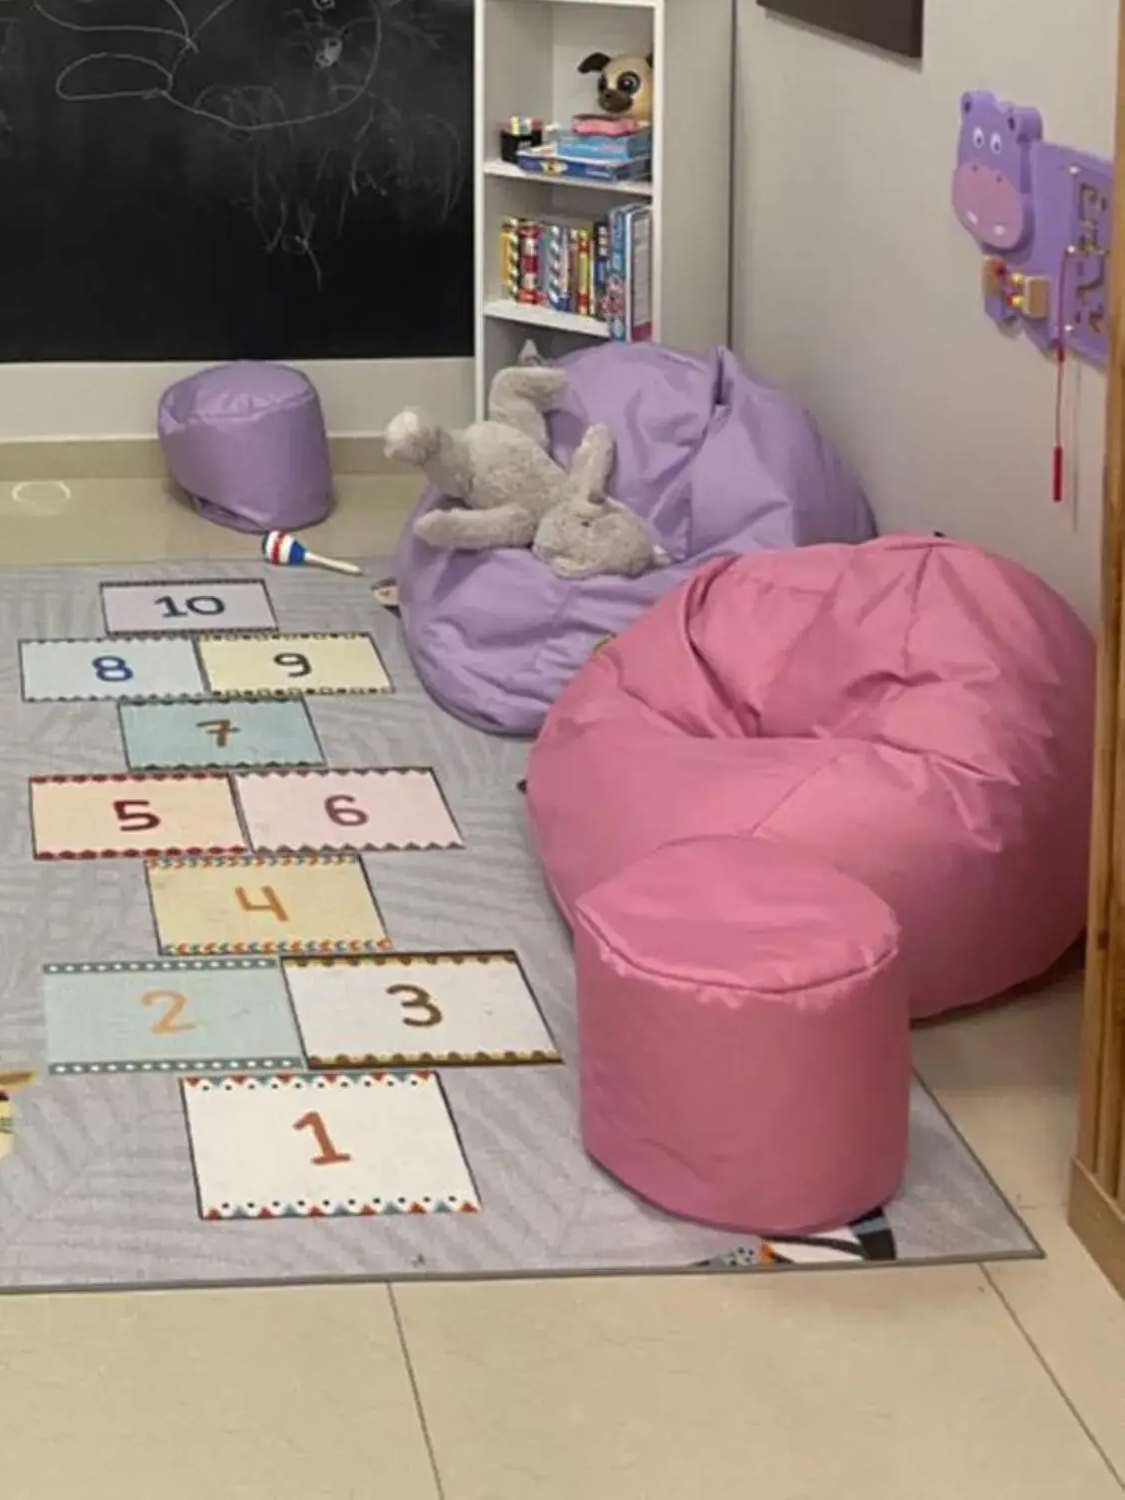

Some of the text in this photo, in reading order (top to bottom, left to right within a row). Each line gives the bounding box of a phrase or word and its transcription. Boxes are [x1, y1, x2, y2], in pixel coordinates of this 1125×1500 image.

[154, 595, 226, 618] 10
[92, 655, 134, 682] 8
[273, 652, 312, 678] 9
[196, 719, 241, 748] 7
[112, 799, 161, 832] 5
[324, 794, 369, 827] 6
[234, 885, 290, 922] 4
[141, 988, 197, 1036] 2
[385, 984, 444, 1028] 3
[292, 1110, 353, 1166] 1
